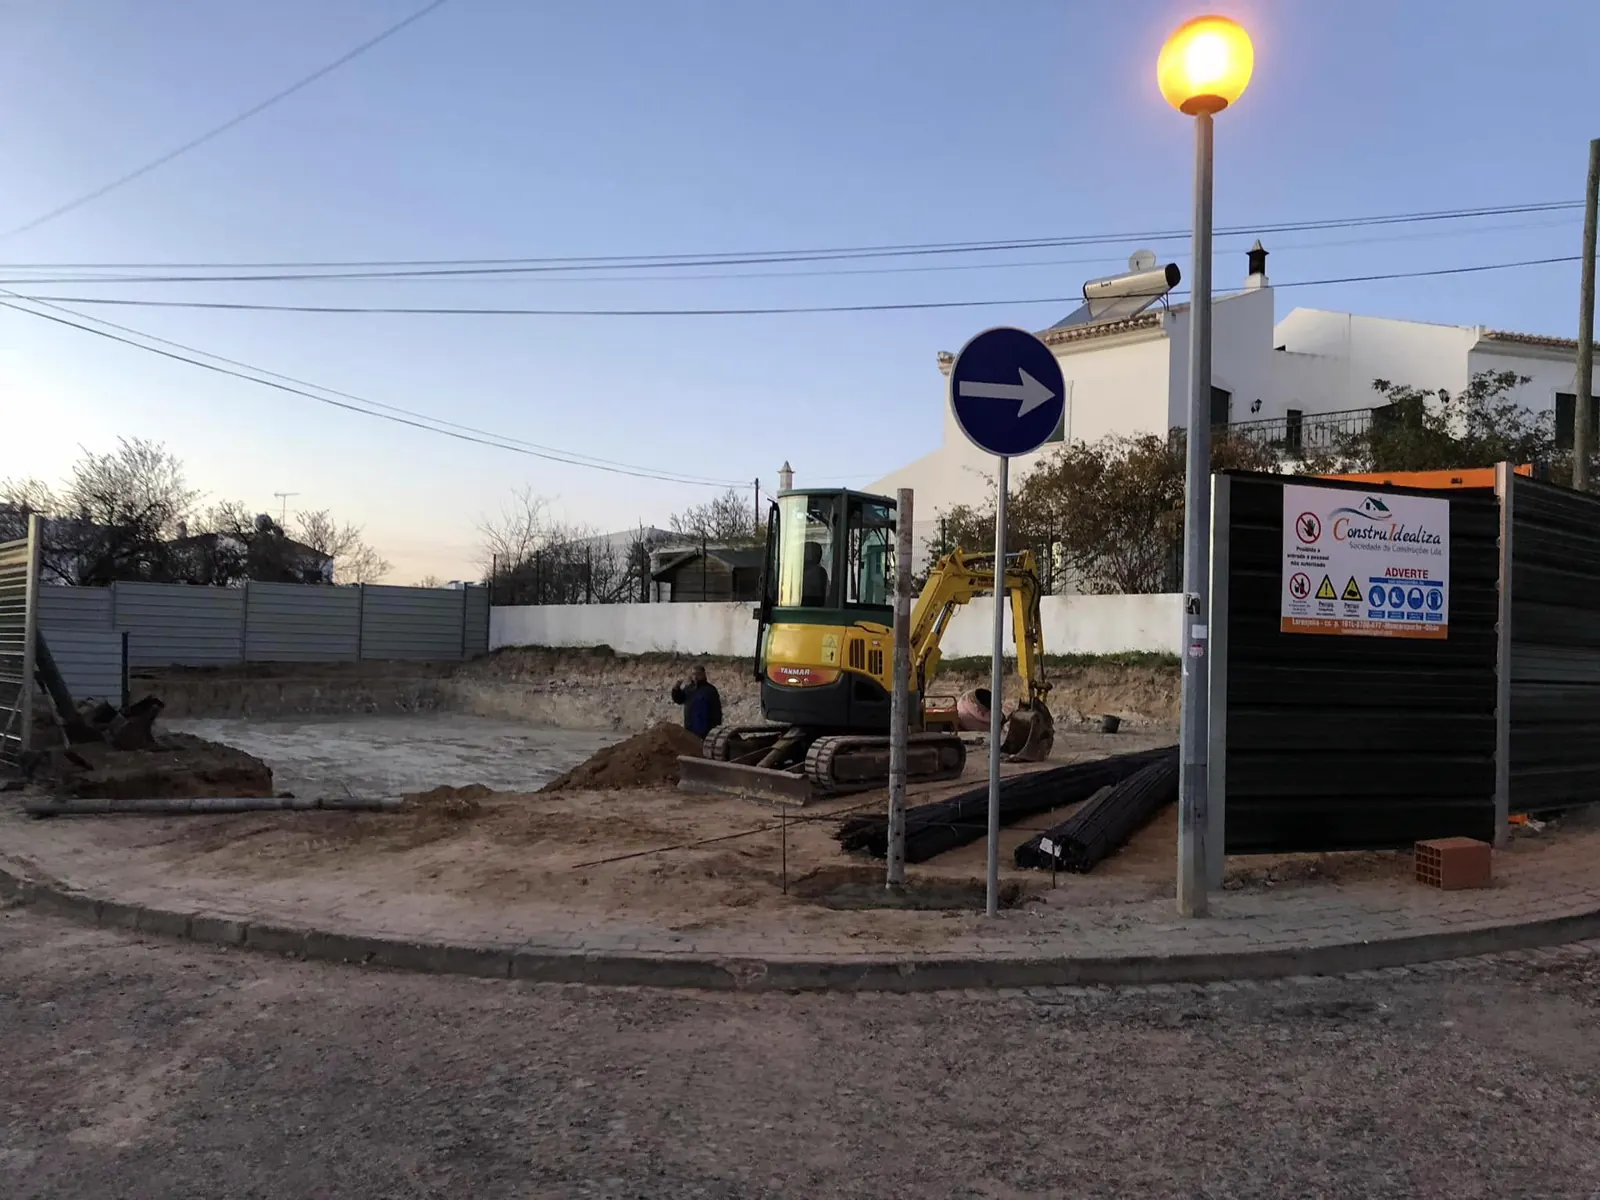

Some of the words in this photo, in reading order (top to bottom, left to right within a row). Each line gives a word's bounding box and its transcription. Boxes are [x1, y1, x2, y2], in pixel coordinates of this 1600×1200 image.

[1333, 517, 1442, 545] ConstruIdealiza
[1349, 541, 1382, 551] Sociedade
[1385, 567, 1429, 579] ADVERTE
[780, 667, 811, 676] YANMAR
